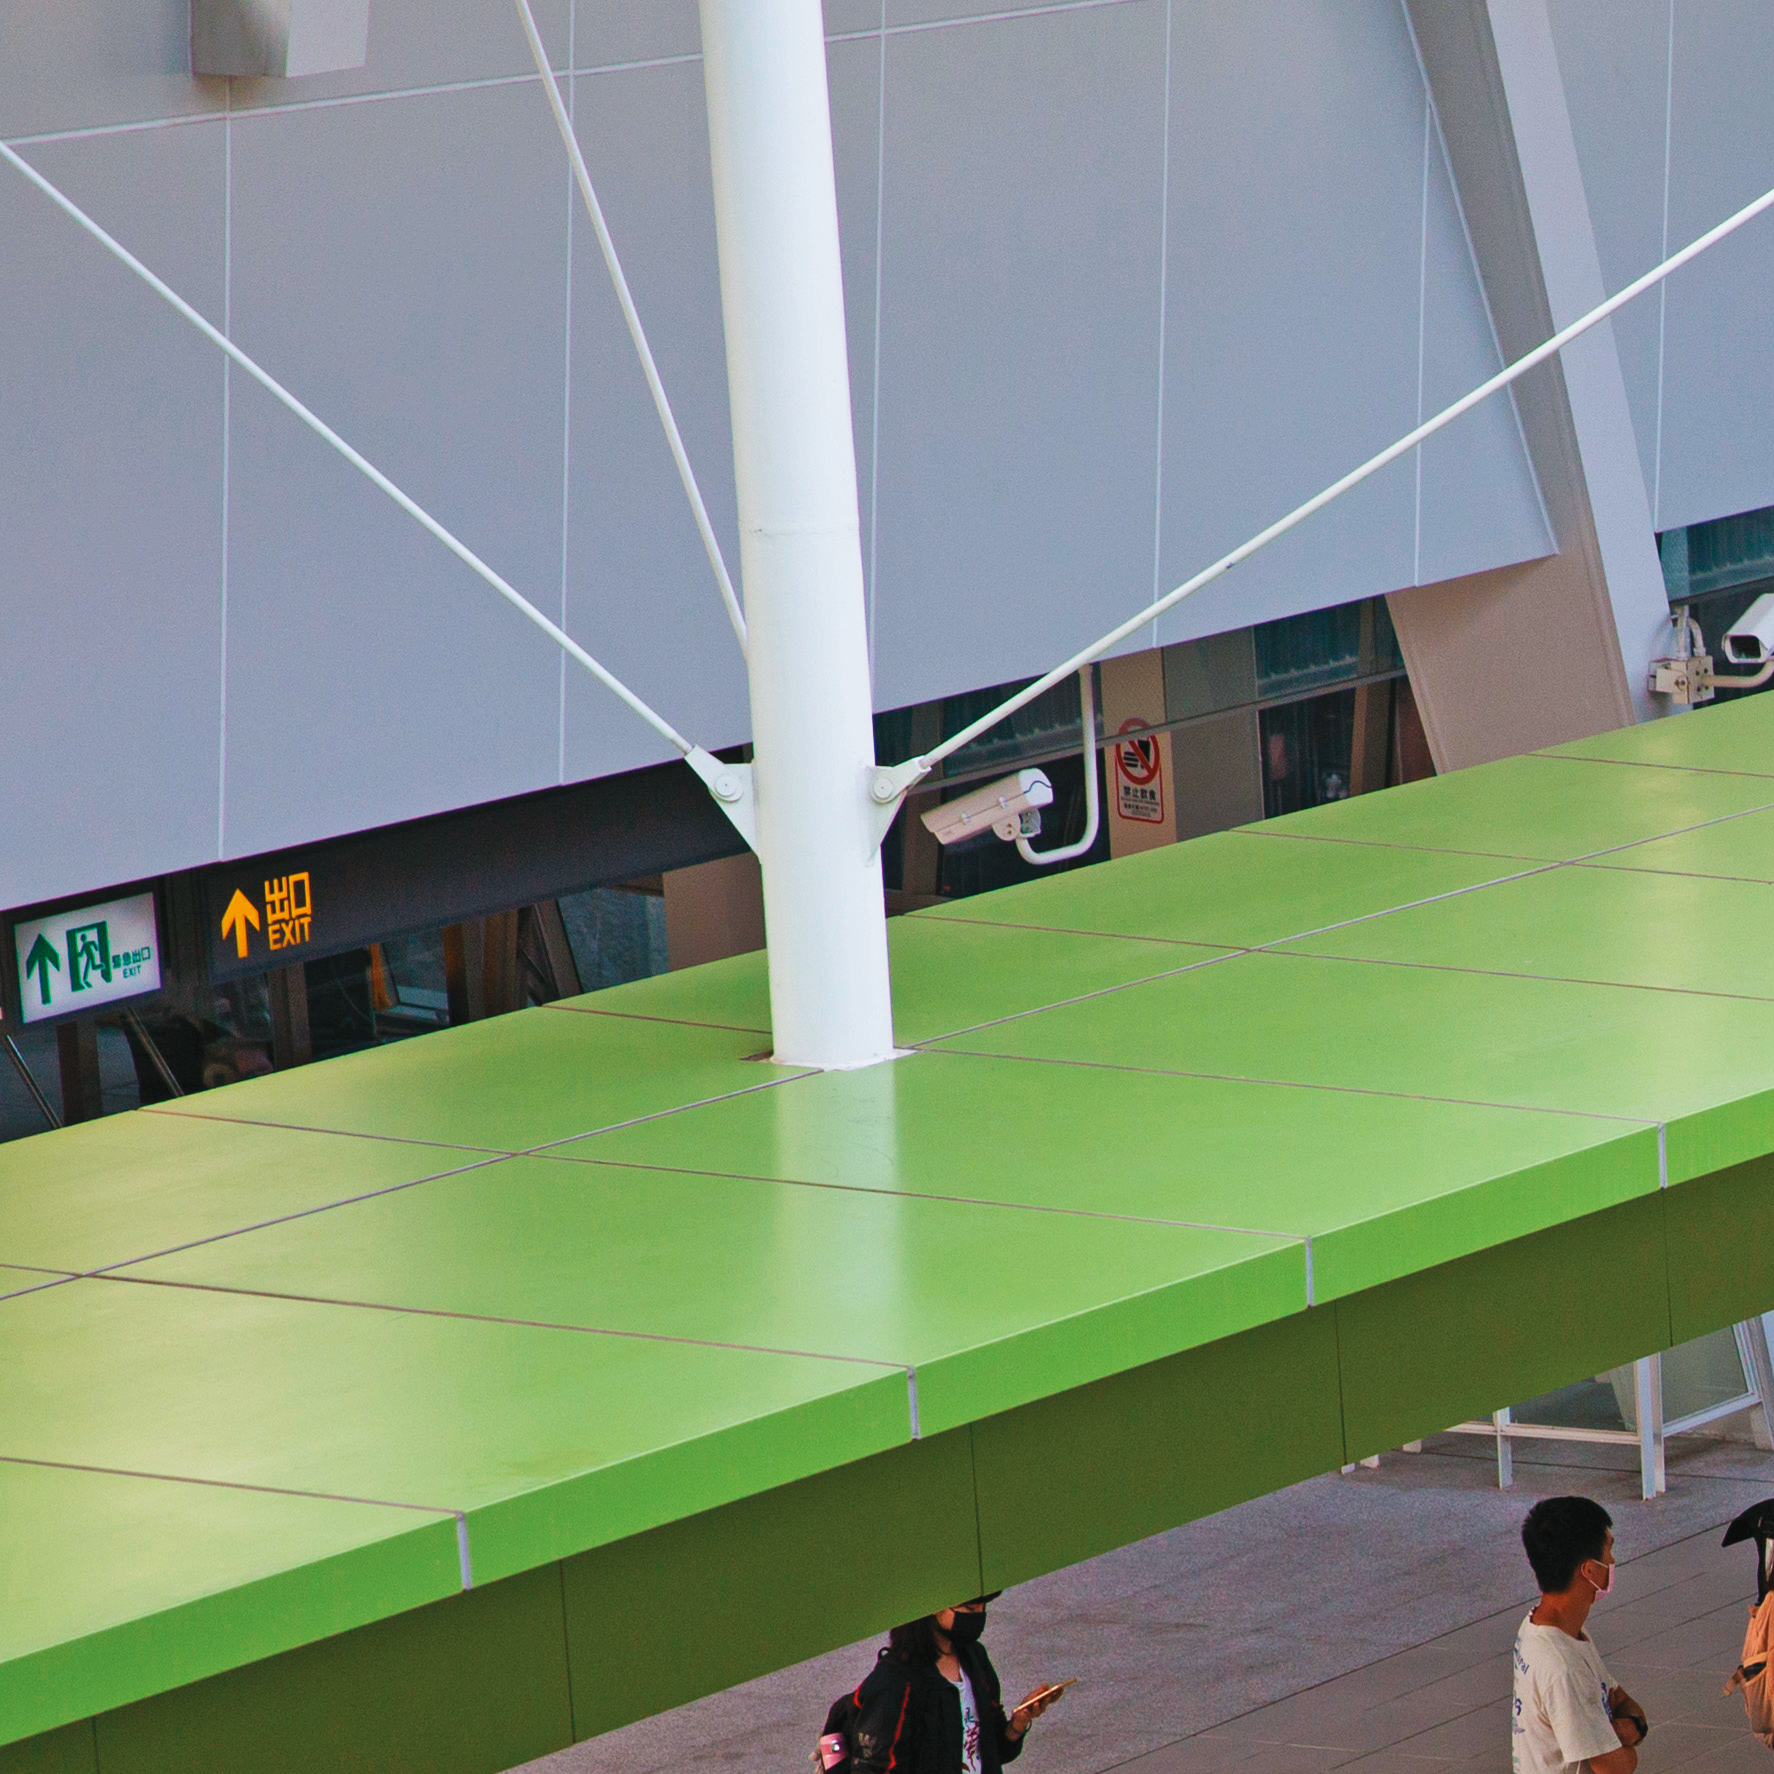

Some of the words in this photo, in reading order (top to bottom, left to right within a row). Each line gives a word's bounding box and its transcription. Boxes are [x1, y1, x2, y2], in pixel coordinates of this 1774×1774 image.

[264, 871, 312, 926] 出口
[267, 916, 312, 951] EXIT
[122, 964, 141, 979] EXIT
